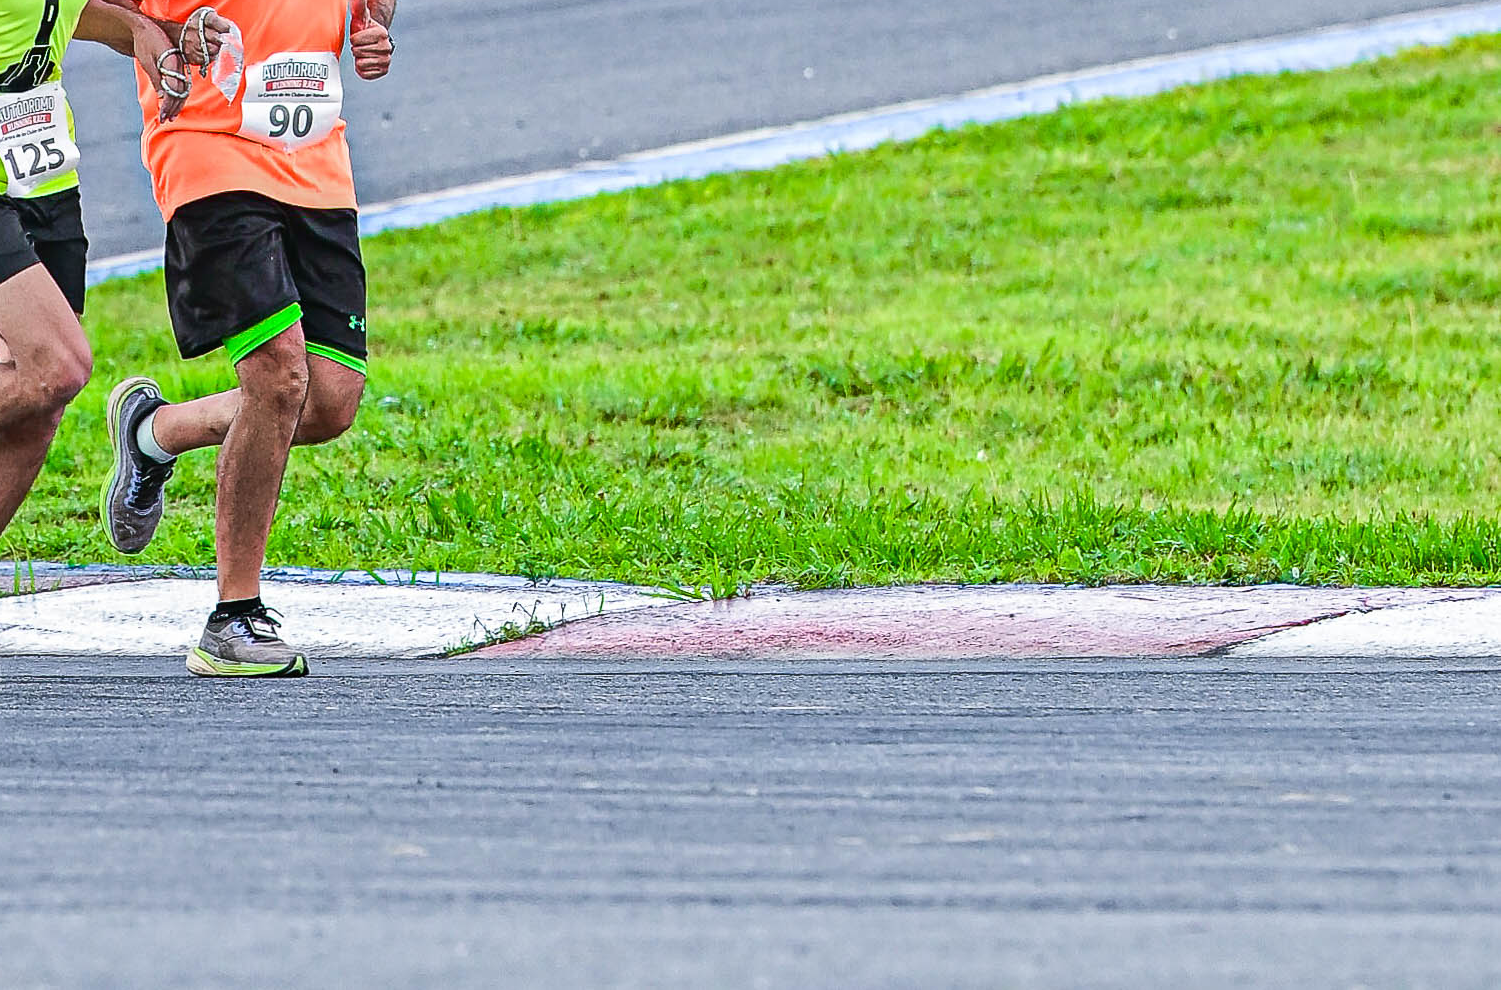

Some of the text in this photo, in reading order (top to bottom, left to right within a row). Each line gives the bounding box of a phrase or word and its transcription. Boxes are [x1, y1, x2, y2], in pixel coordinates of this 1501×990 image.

[262, 58, 329, 82] AUTÓDROMO
[272, 80, 321, 90] RUNNING RACE
[269, 105, 313, 138] 90
[4, 138, 65, 180] 125
